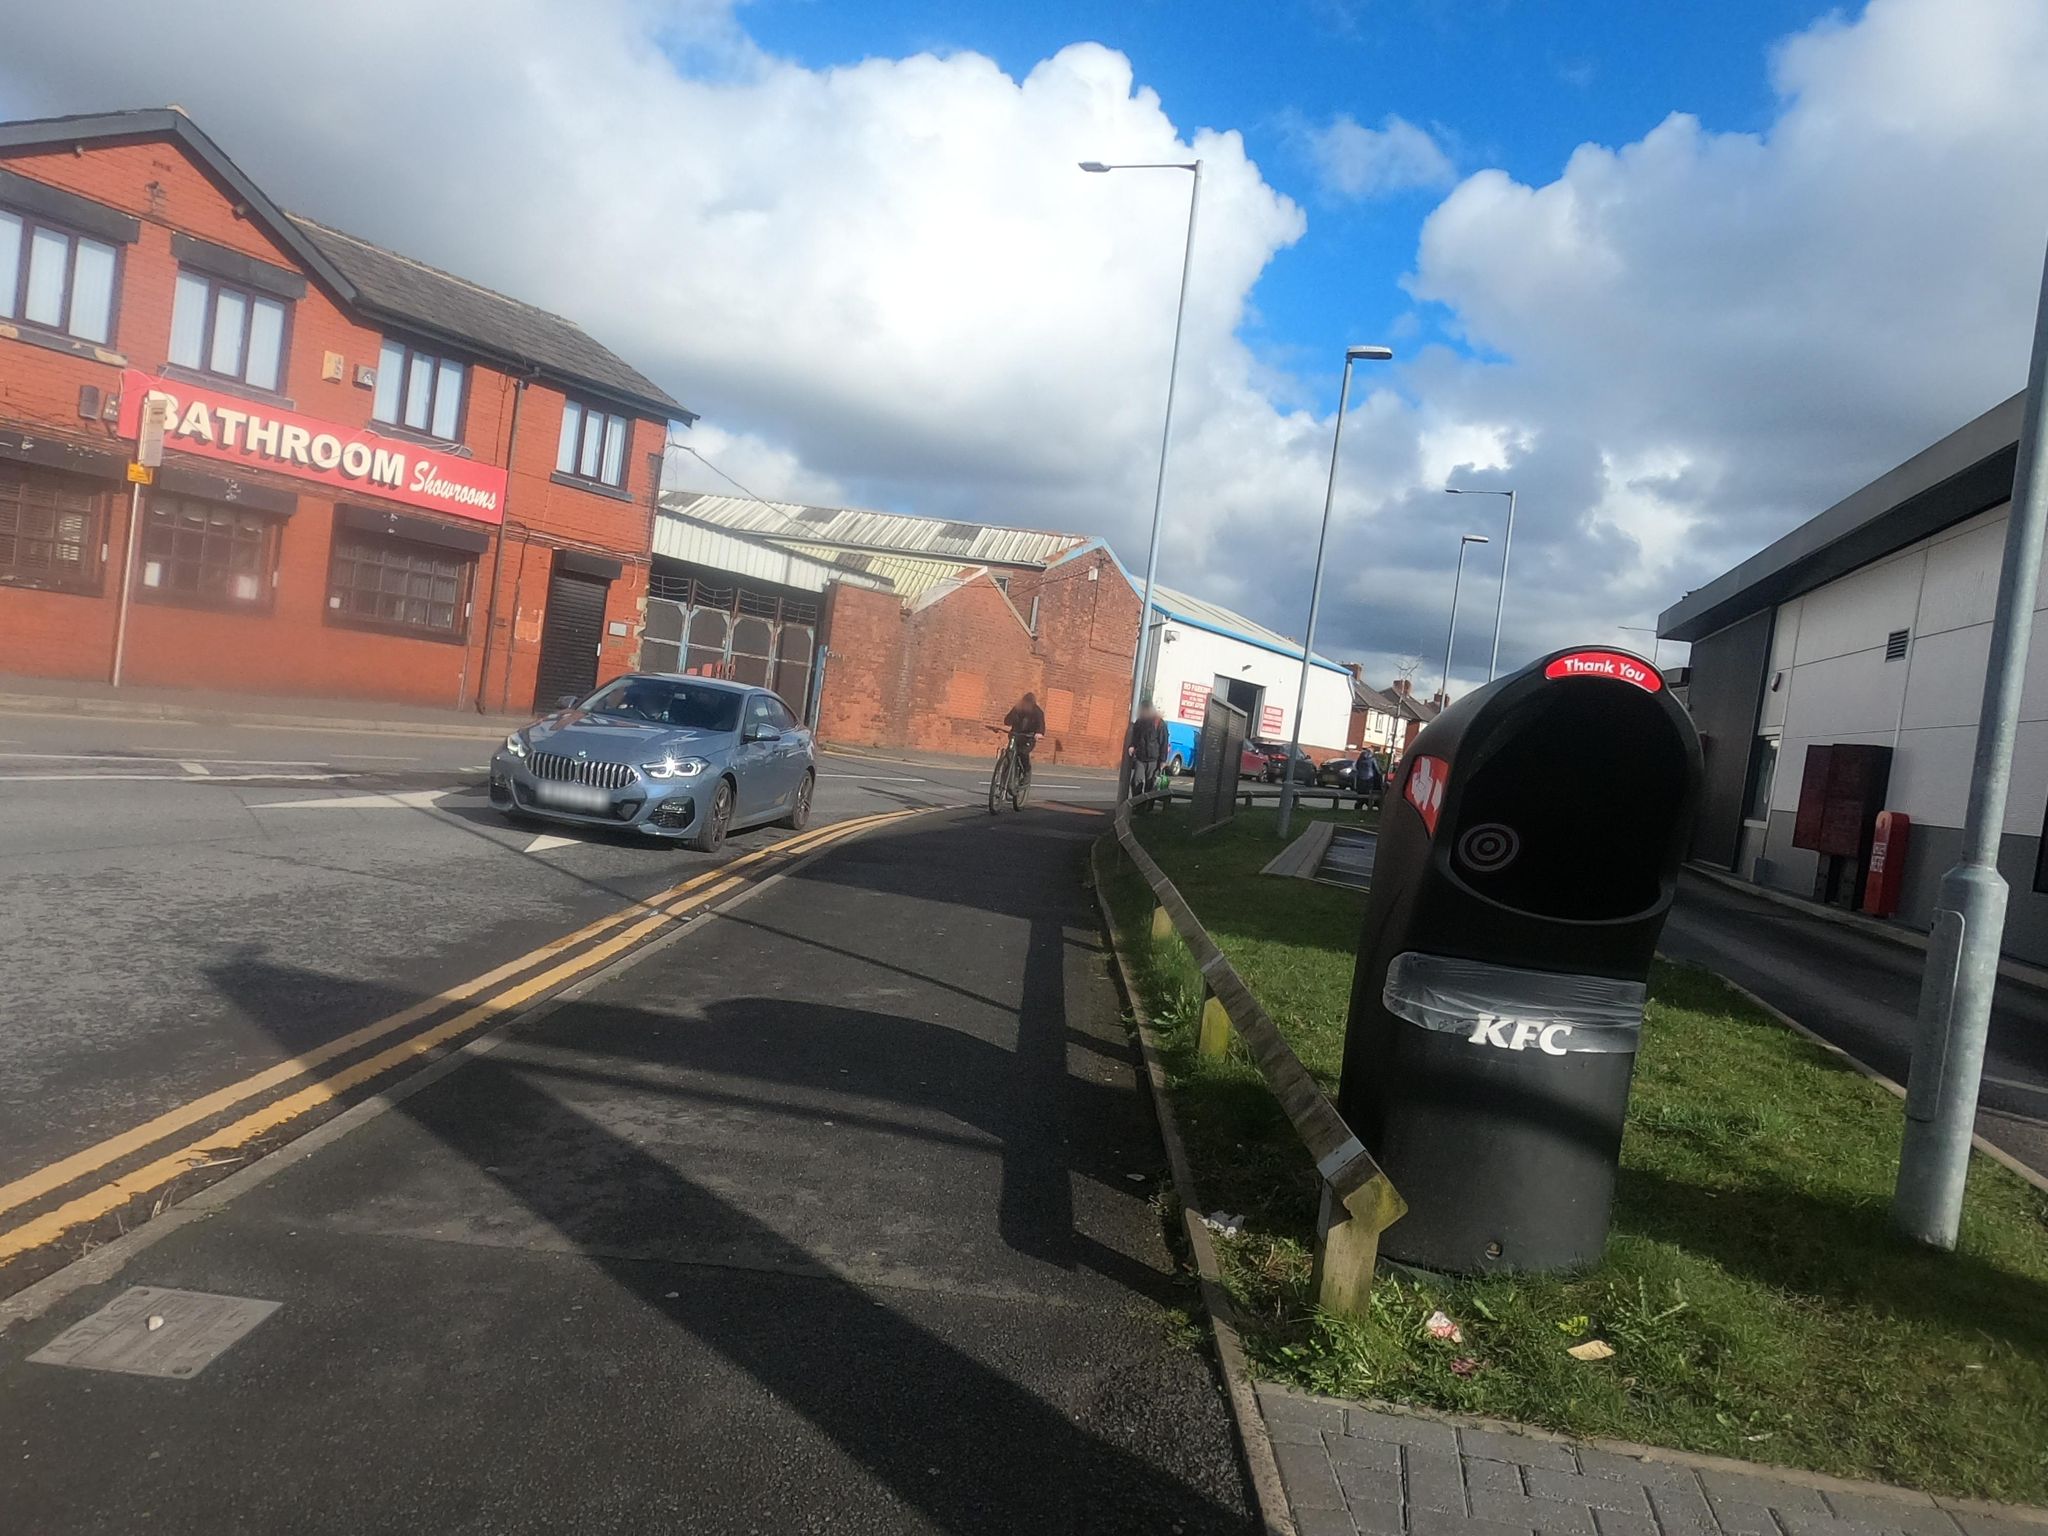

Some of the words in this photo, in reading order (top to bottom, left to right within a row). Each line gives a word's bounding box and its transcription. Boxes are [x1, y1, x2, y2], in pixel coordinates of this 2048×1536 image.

[148, 389, 405, 487] BATHROOM
[409, 460, 497, 511] Showrooms
[1564, 658, 1615, 673] Thank
[1619, 662, 1645, 681] You
[1468, 1013, 1573, 1055] KFC
